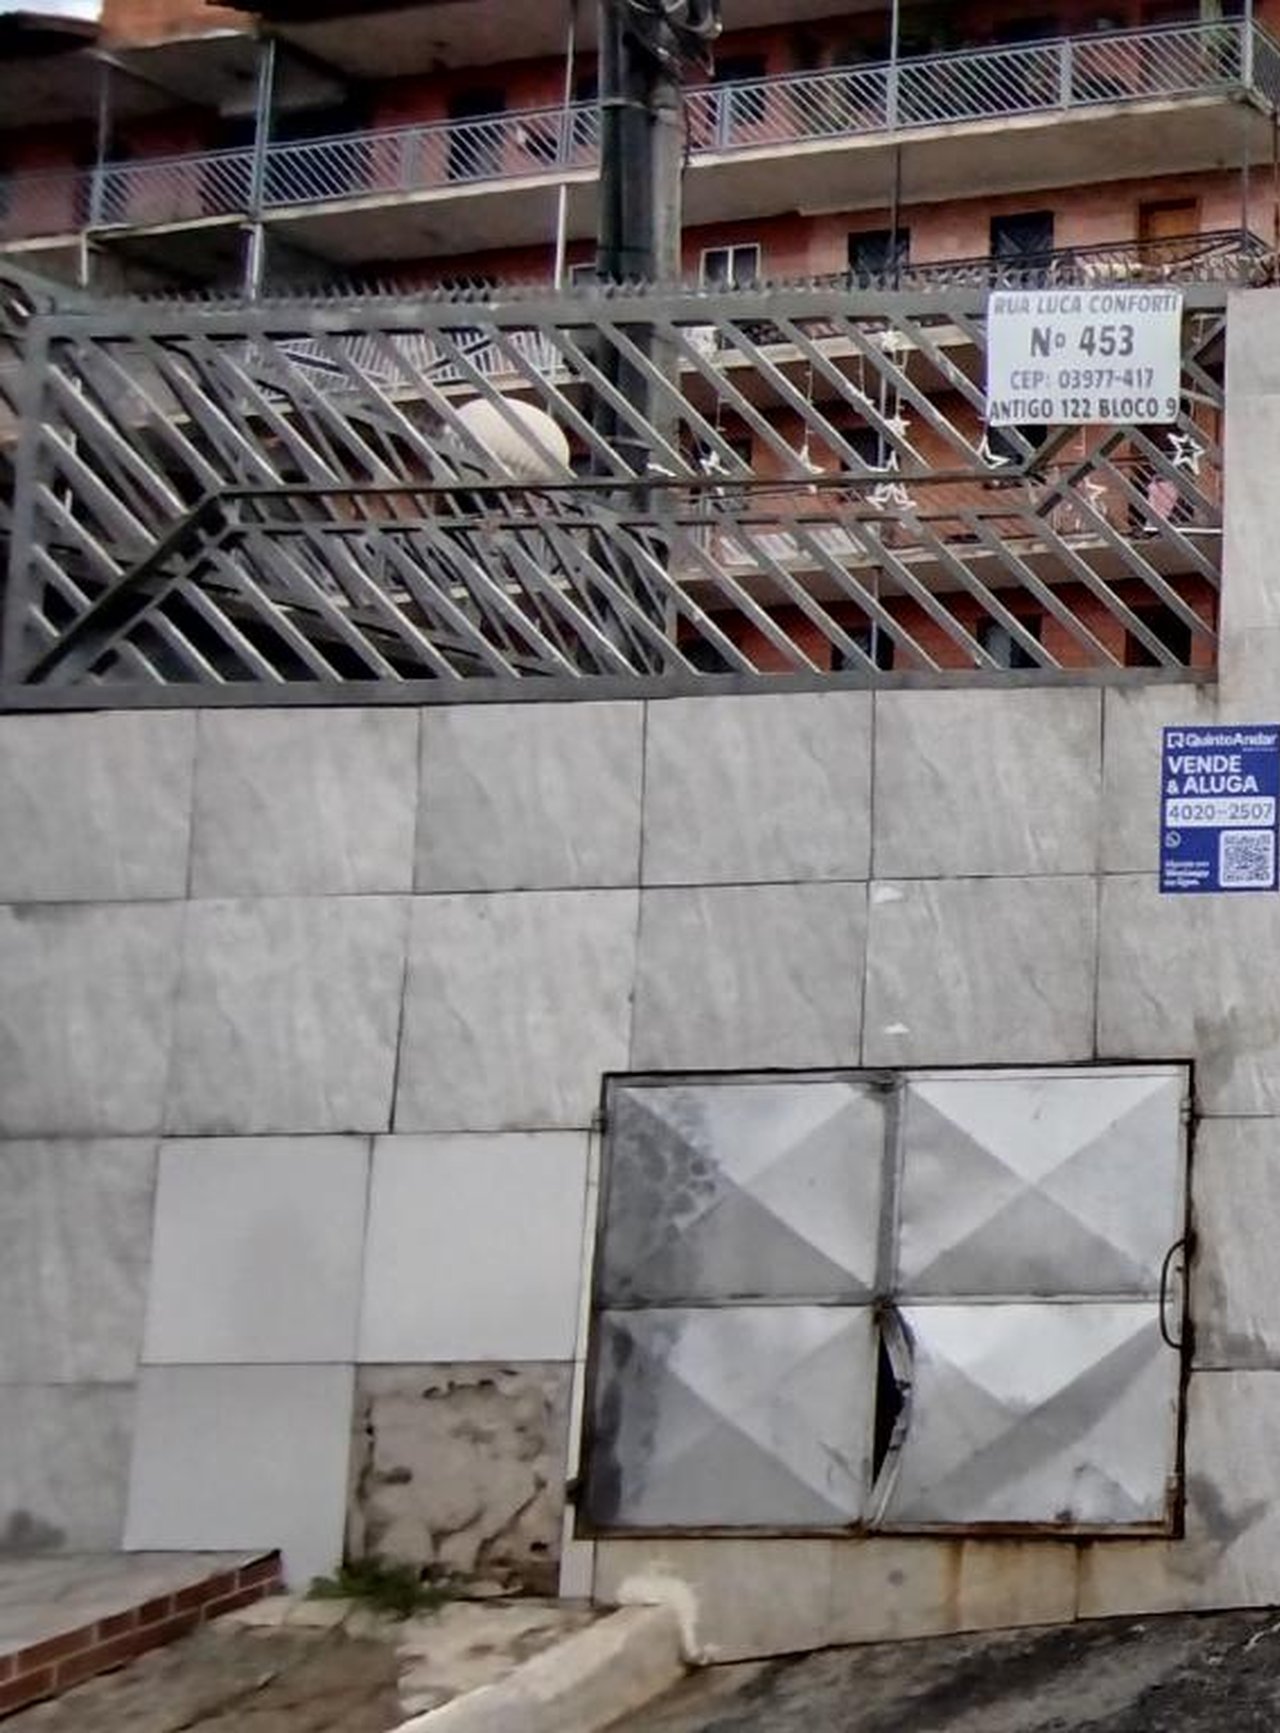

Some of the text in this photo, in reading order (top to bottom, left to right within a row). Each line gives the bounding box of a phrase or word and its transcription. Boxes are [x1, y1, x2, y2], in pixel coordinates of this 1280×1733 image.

[995, 293, 1177, 315] RUA LUCA CONFORTI
[1079, 324, 1135, 356] 453
[1010, 368, 1154, 390] CEP: 03977-417
[990, 398, 1177, 419] ANTIGO 122 BLOCO 9
[1185, 732, 1278, 747] QuintoAndar
[1167, 755, 1242, 774] VENDE
[1167, 775, 1259, 795] & ALUGA
[1169, 803, 1273, 820] 4020-2507
